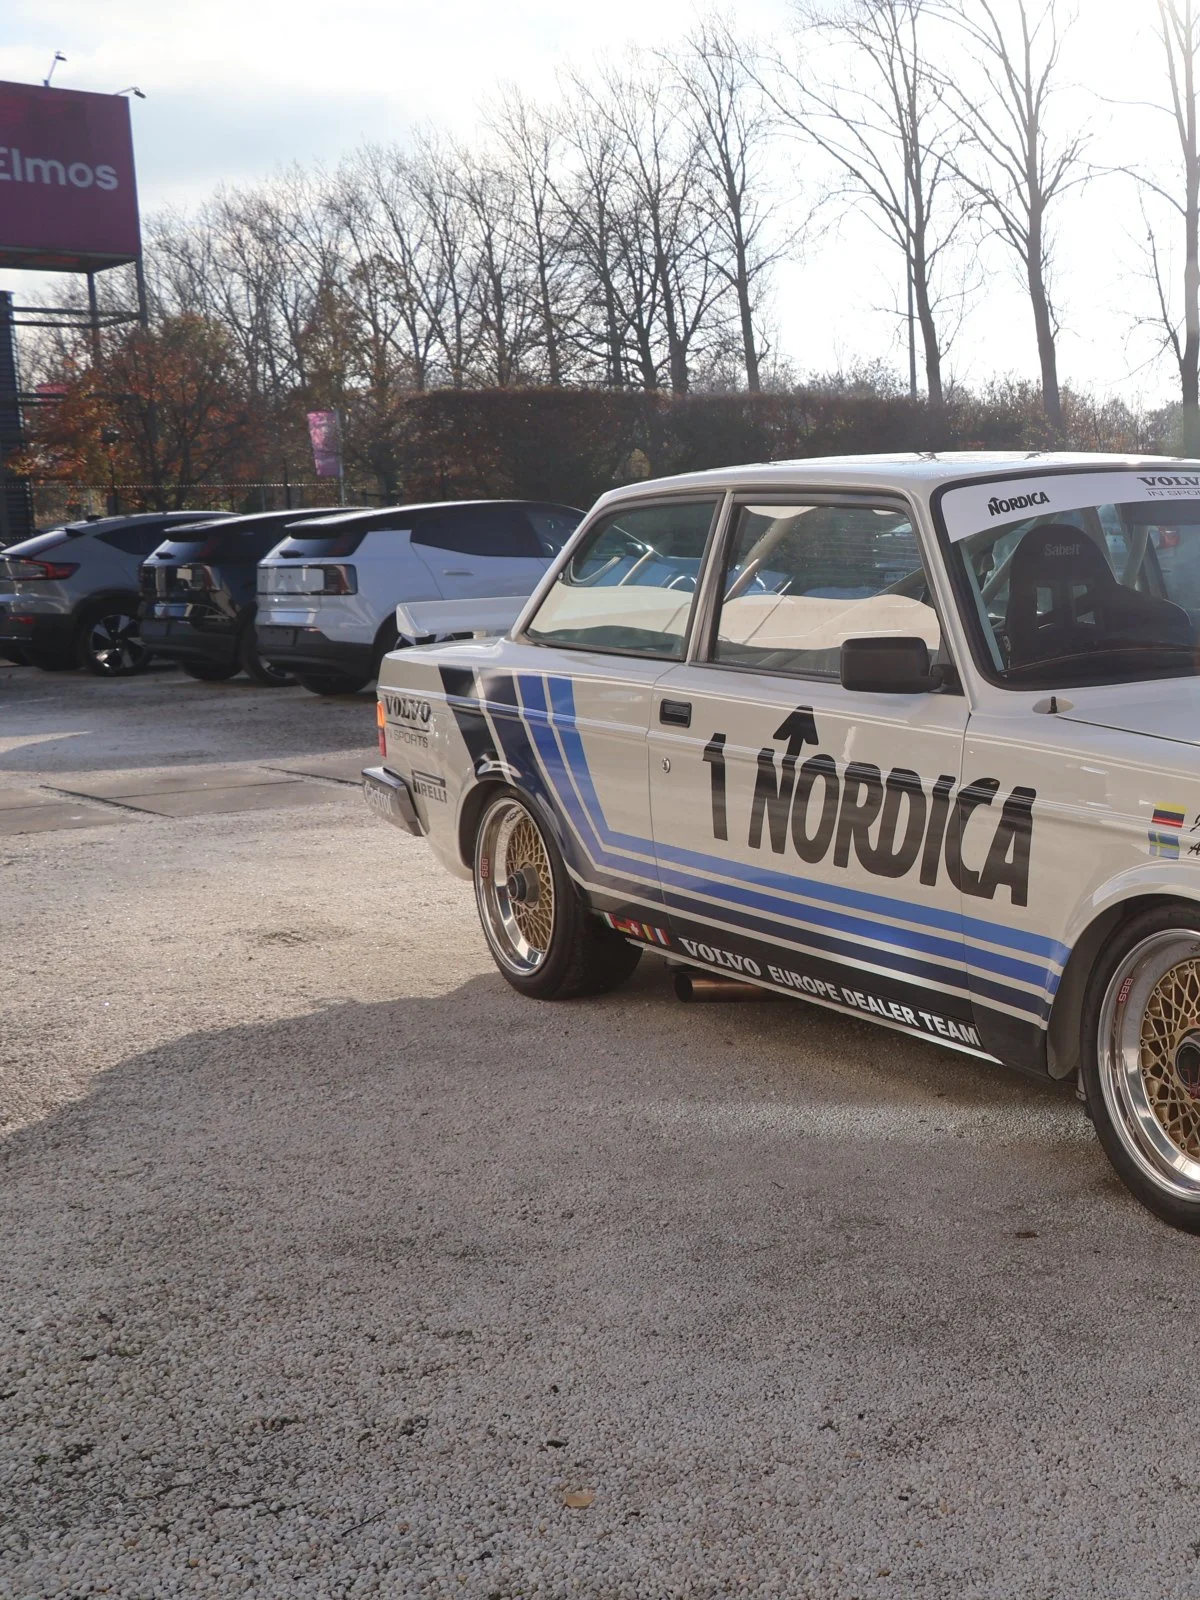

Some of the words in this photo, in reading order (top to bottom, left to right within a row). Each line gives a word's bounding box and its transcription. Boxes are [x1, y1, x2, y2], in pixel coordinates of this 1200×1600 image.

[988, 491, 1050, 516] NORDICA
[384, 694, 431, 723] VOLVO
[411, 768, 447, 804] PIRELLI
[748, 706, 1036, 907] NORDICA
[678, 937, 762, 977] VOLVO
[767, 965, 840, 1002] EUROPE
[841, 987, 920, 1027] DEALER
[918, 1011, 982, 1047] TEAM
[1118, 978, 1134, 1002] BBS
